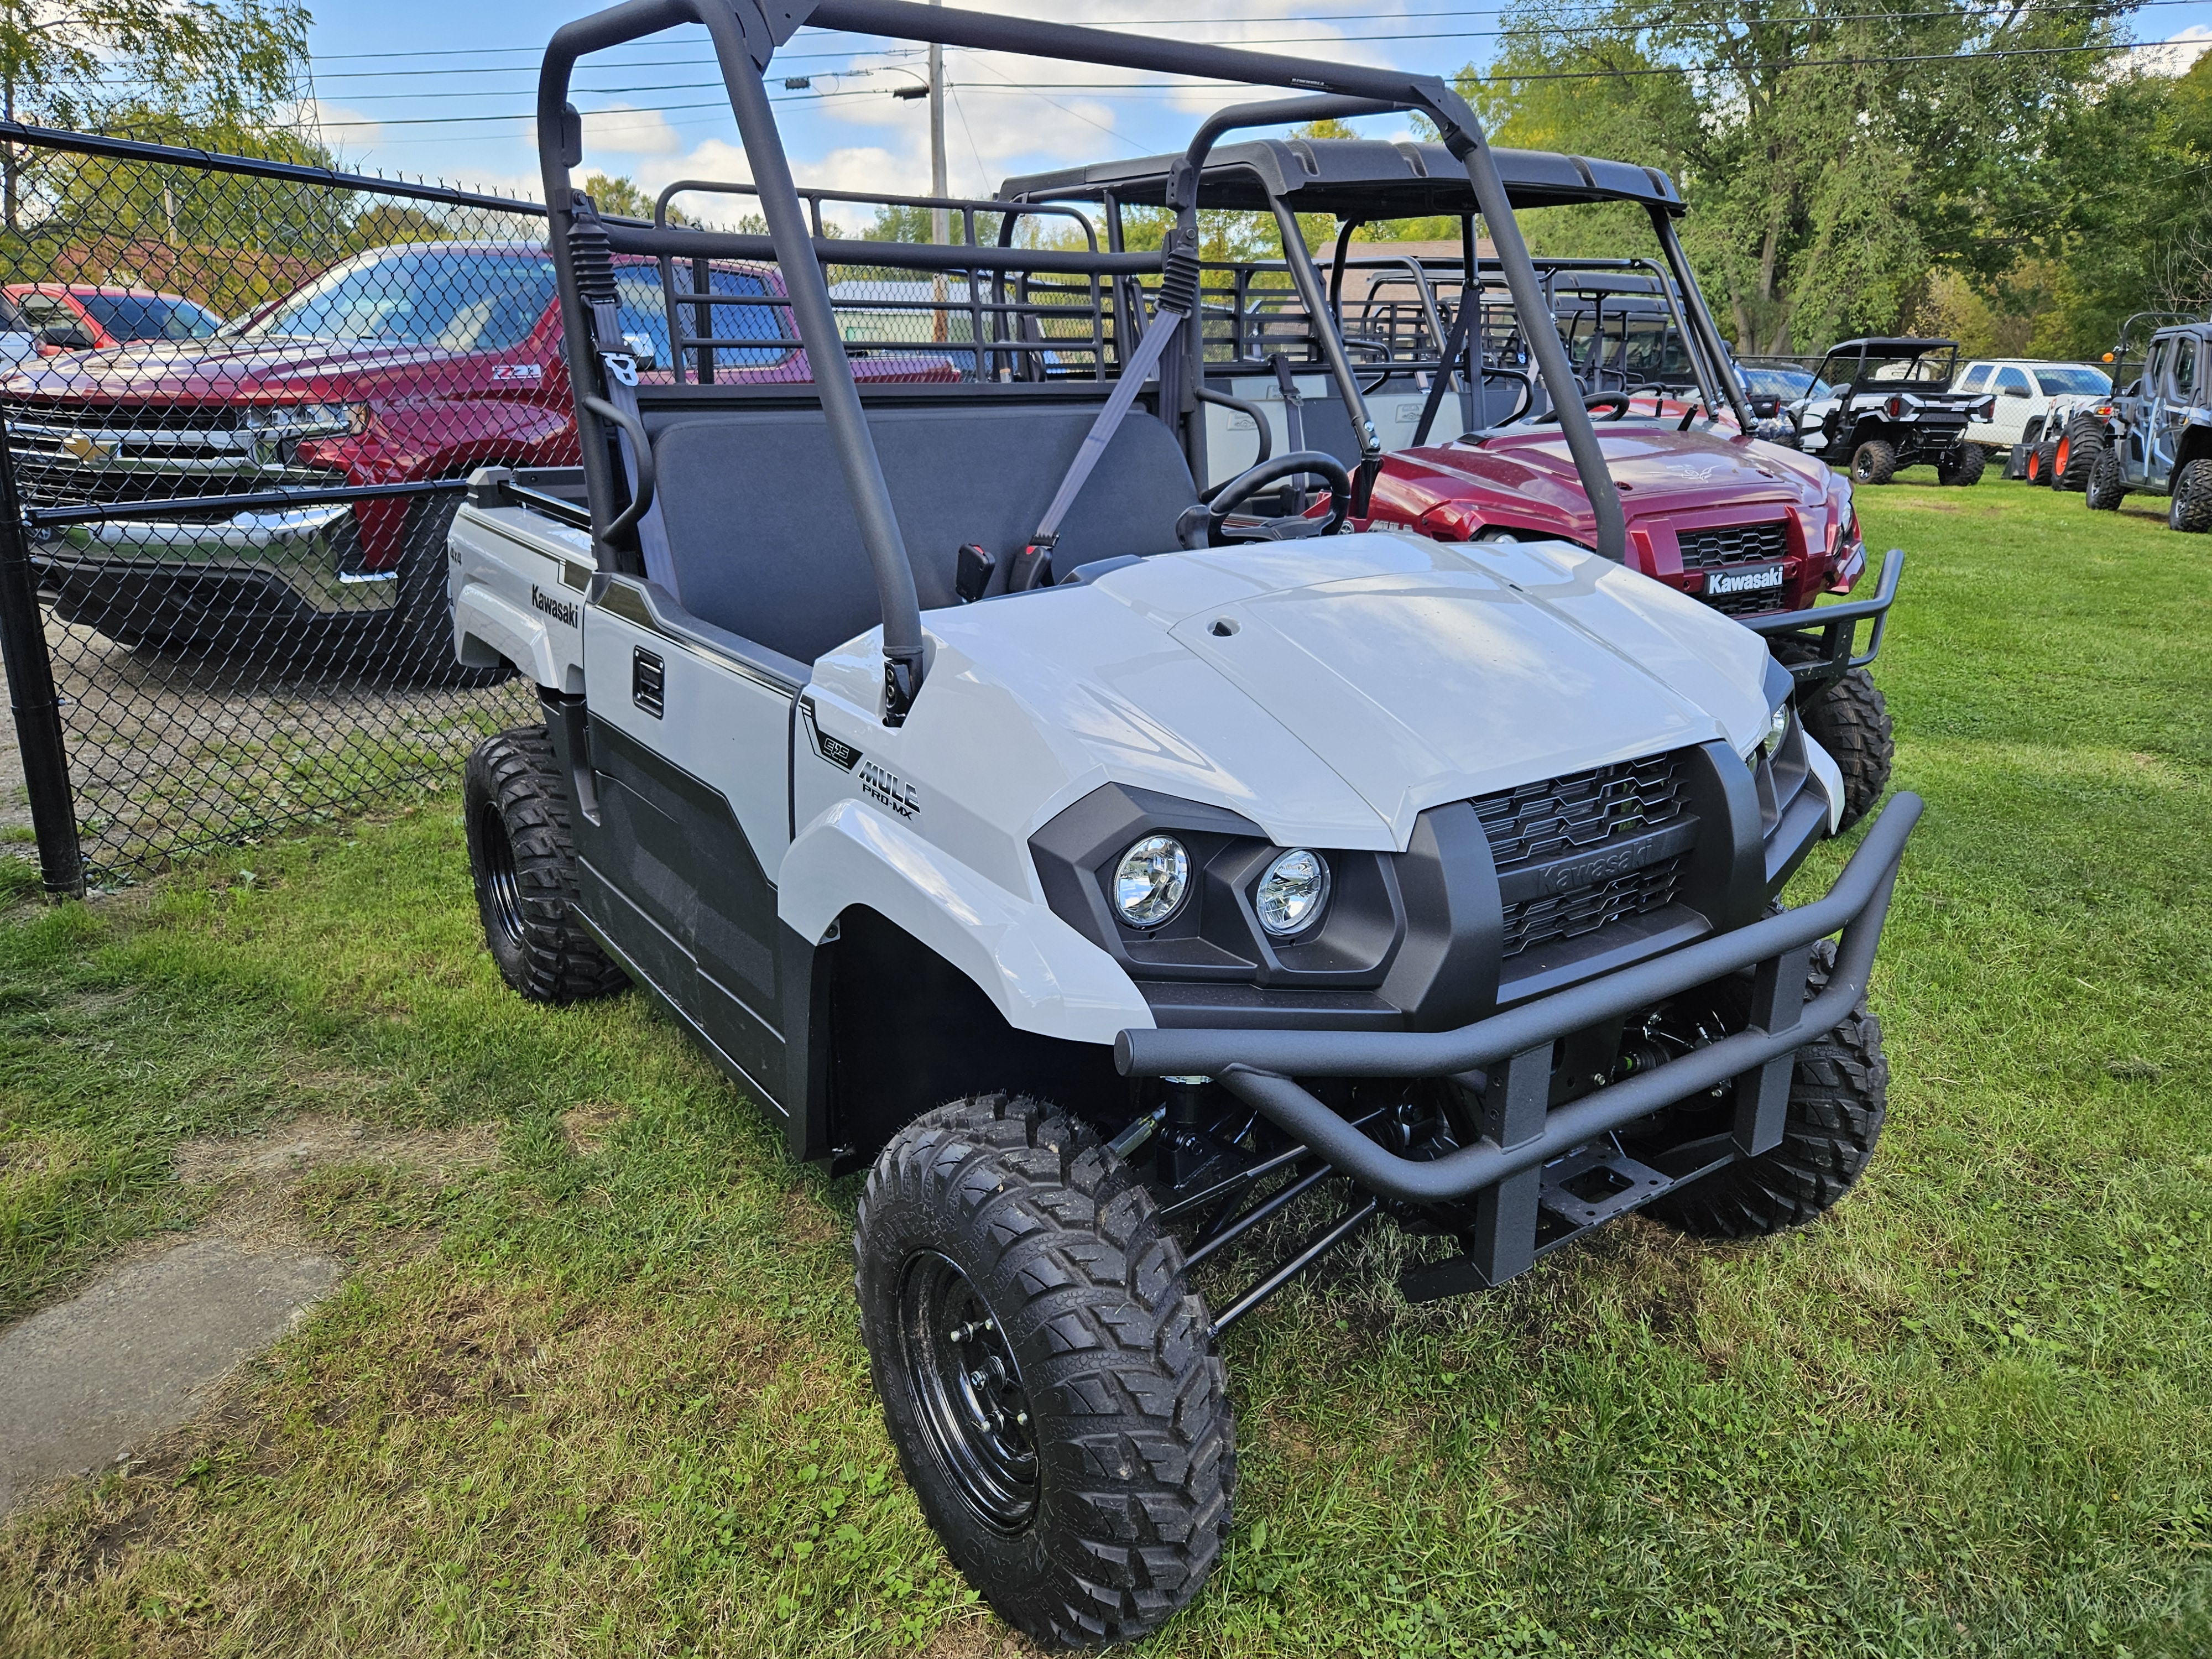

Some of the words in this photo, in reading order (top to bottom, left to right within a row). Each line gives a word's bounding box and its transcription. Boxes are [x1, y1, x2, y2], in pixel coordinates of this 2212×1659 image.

[450, 546, 462, 566] 4x4
[1708, 565, 1784, 595] Kawasaki
[531, 584, 578, 629] Kawasaki
[823, 738, 850, 759] EPS
[858, 760, 921, 815] MULE
[862, 783, 913, 821] PRO-MX
[1537, 838, 1652, 896] Kawasaki
